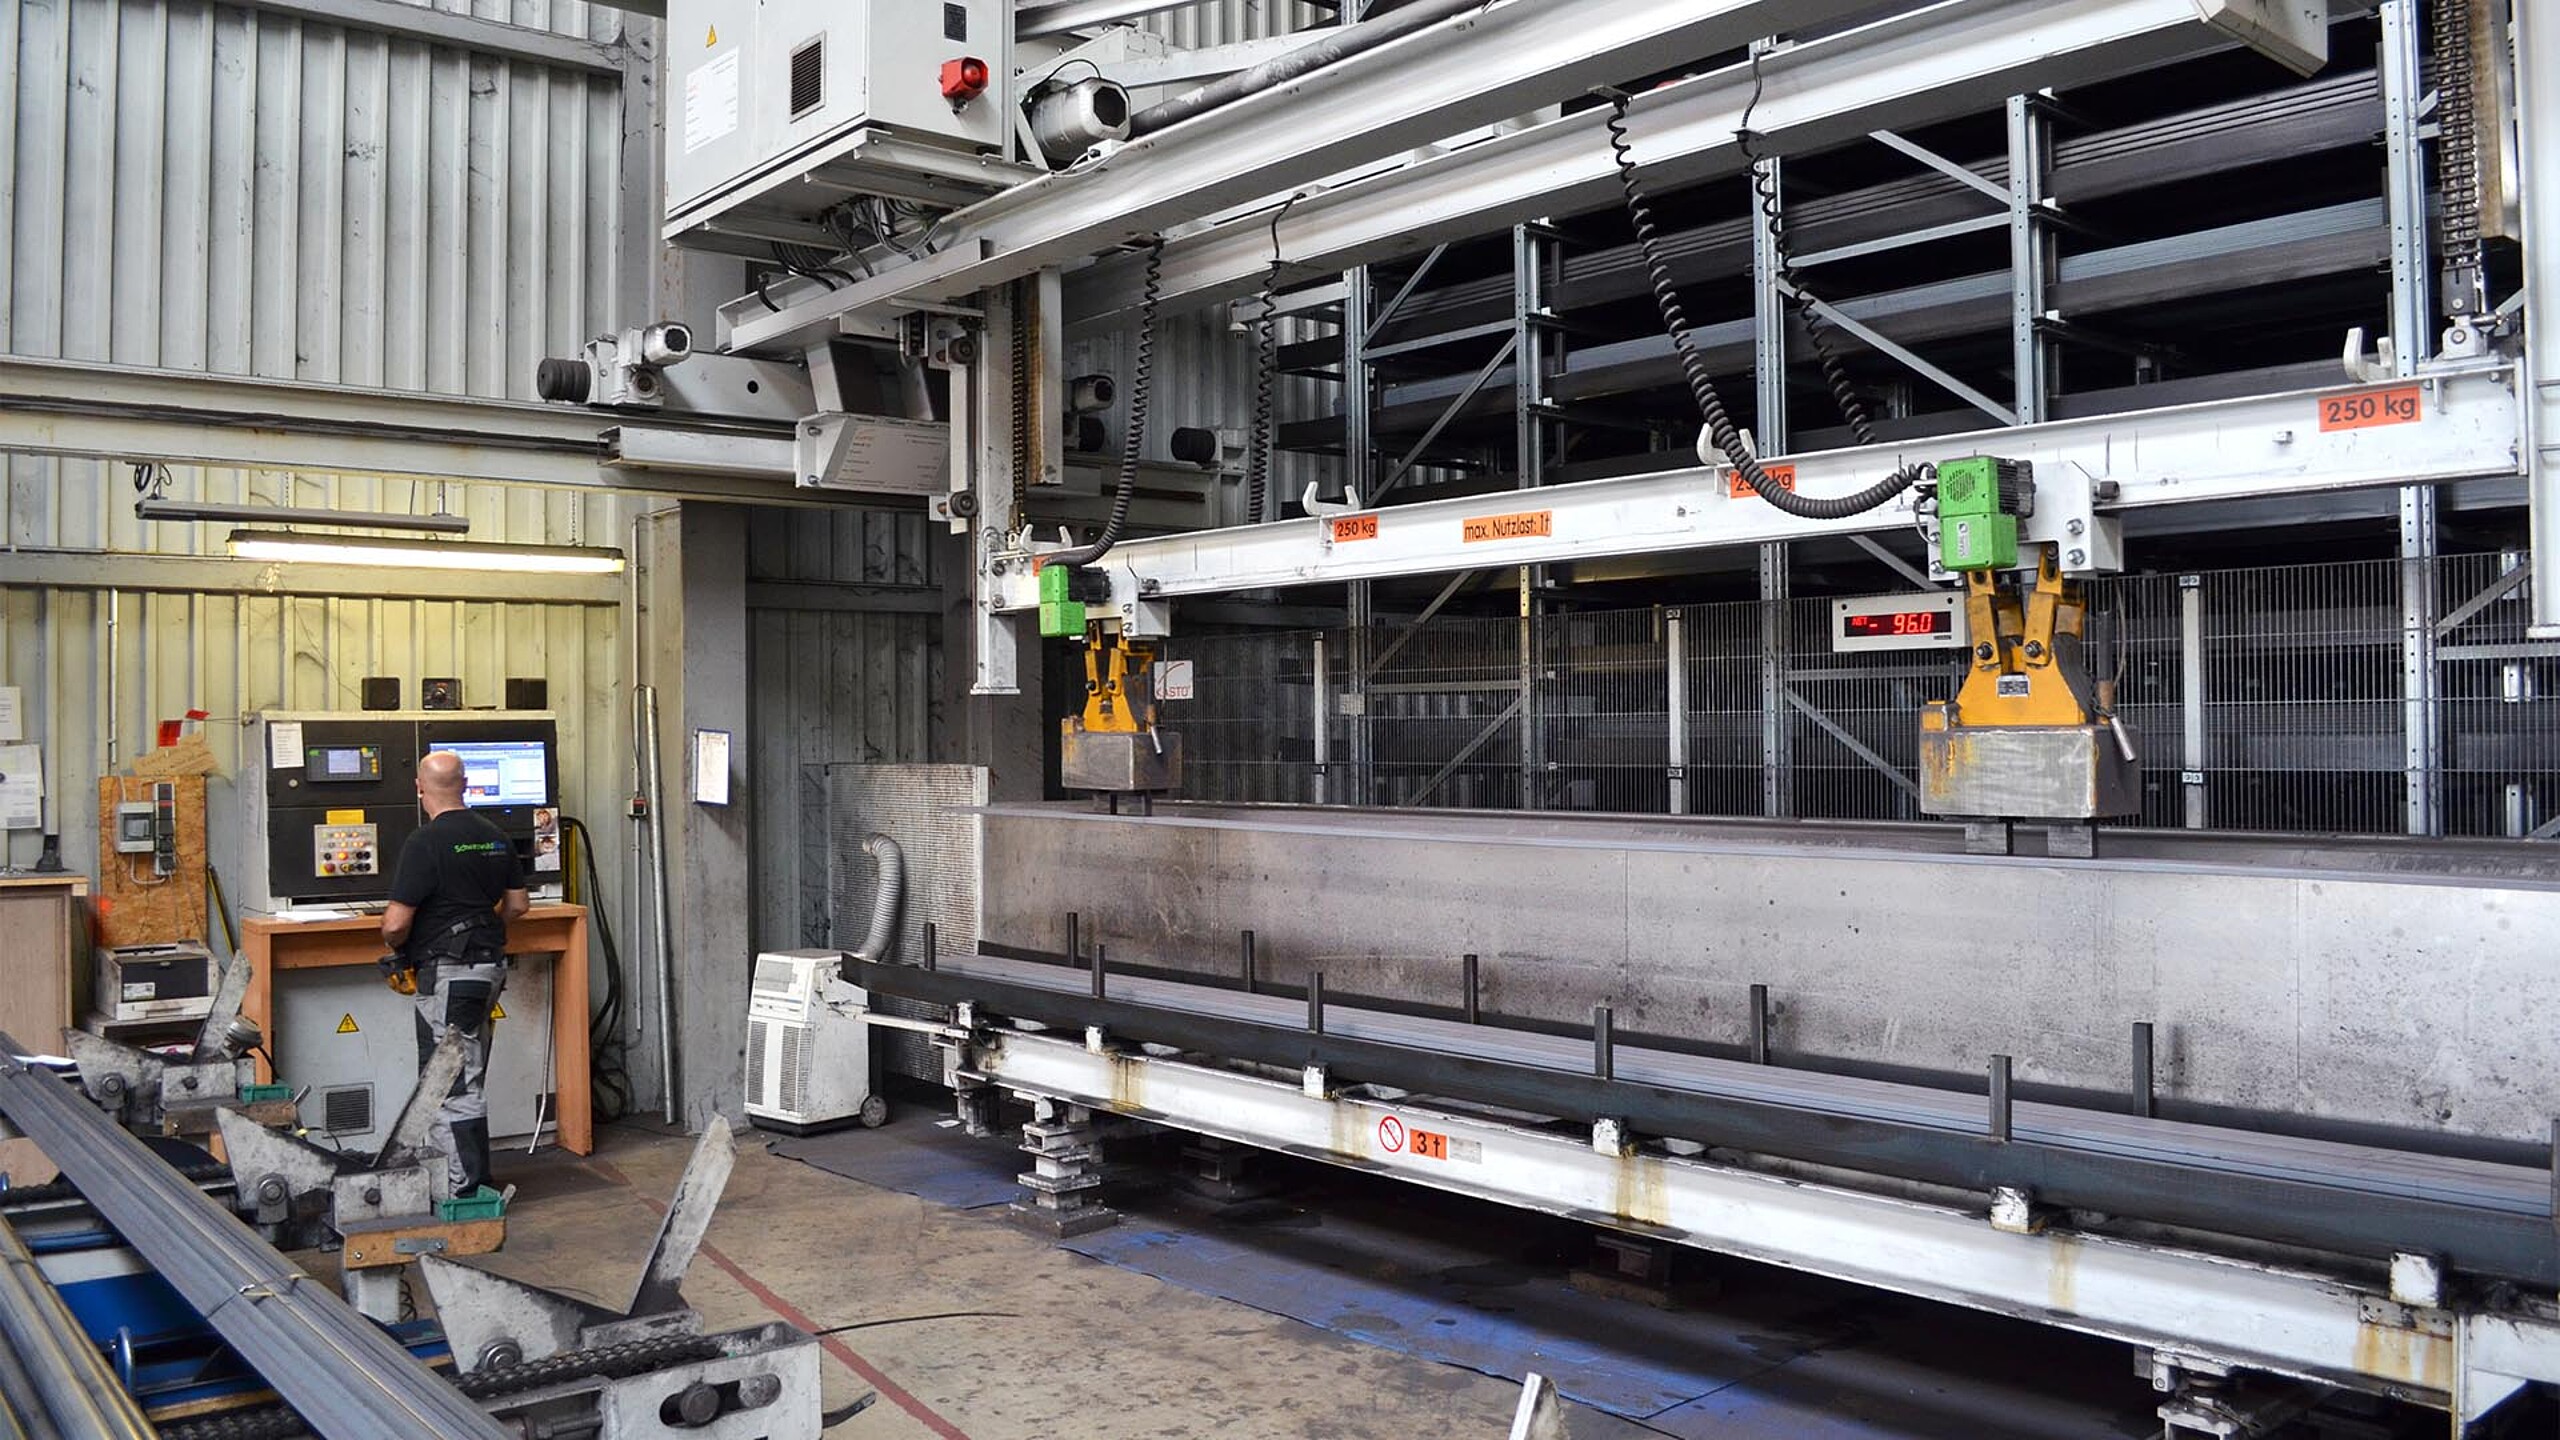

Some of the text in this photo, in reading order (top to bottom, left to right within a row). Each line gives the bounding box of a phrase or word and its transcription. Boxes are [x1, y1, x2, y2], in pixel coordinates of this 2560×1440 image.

[2327, 394, 2415, 424] 250 kg
[1337, 518, 1376, 538] 250 kg
[1464, 524, 1489, 540] max.
[1493, 515, 1537, 538] Nutzlast:
[1416, 1132, 1427, 1154] 3
[1433, 1136, 1441, 1158] t
